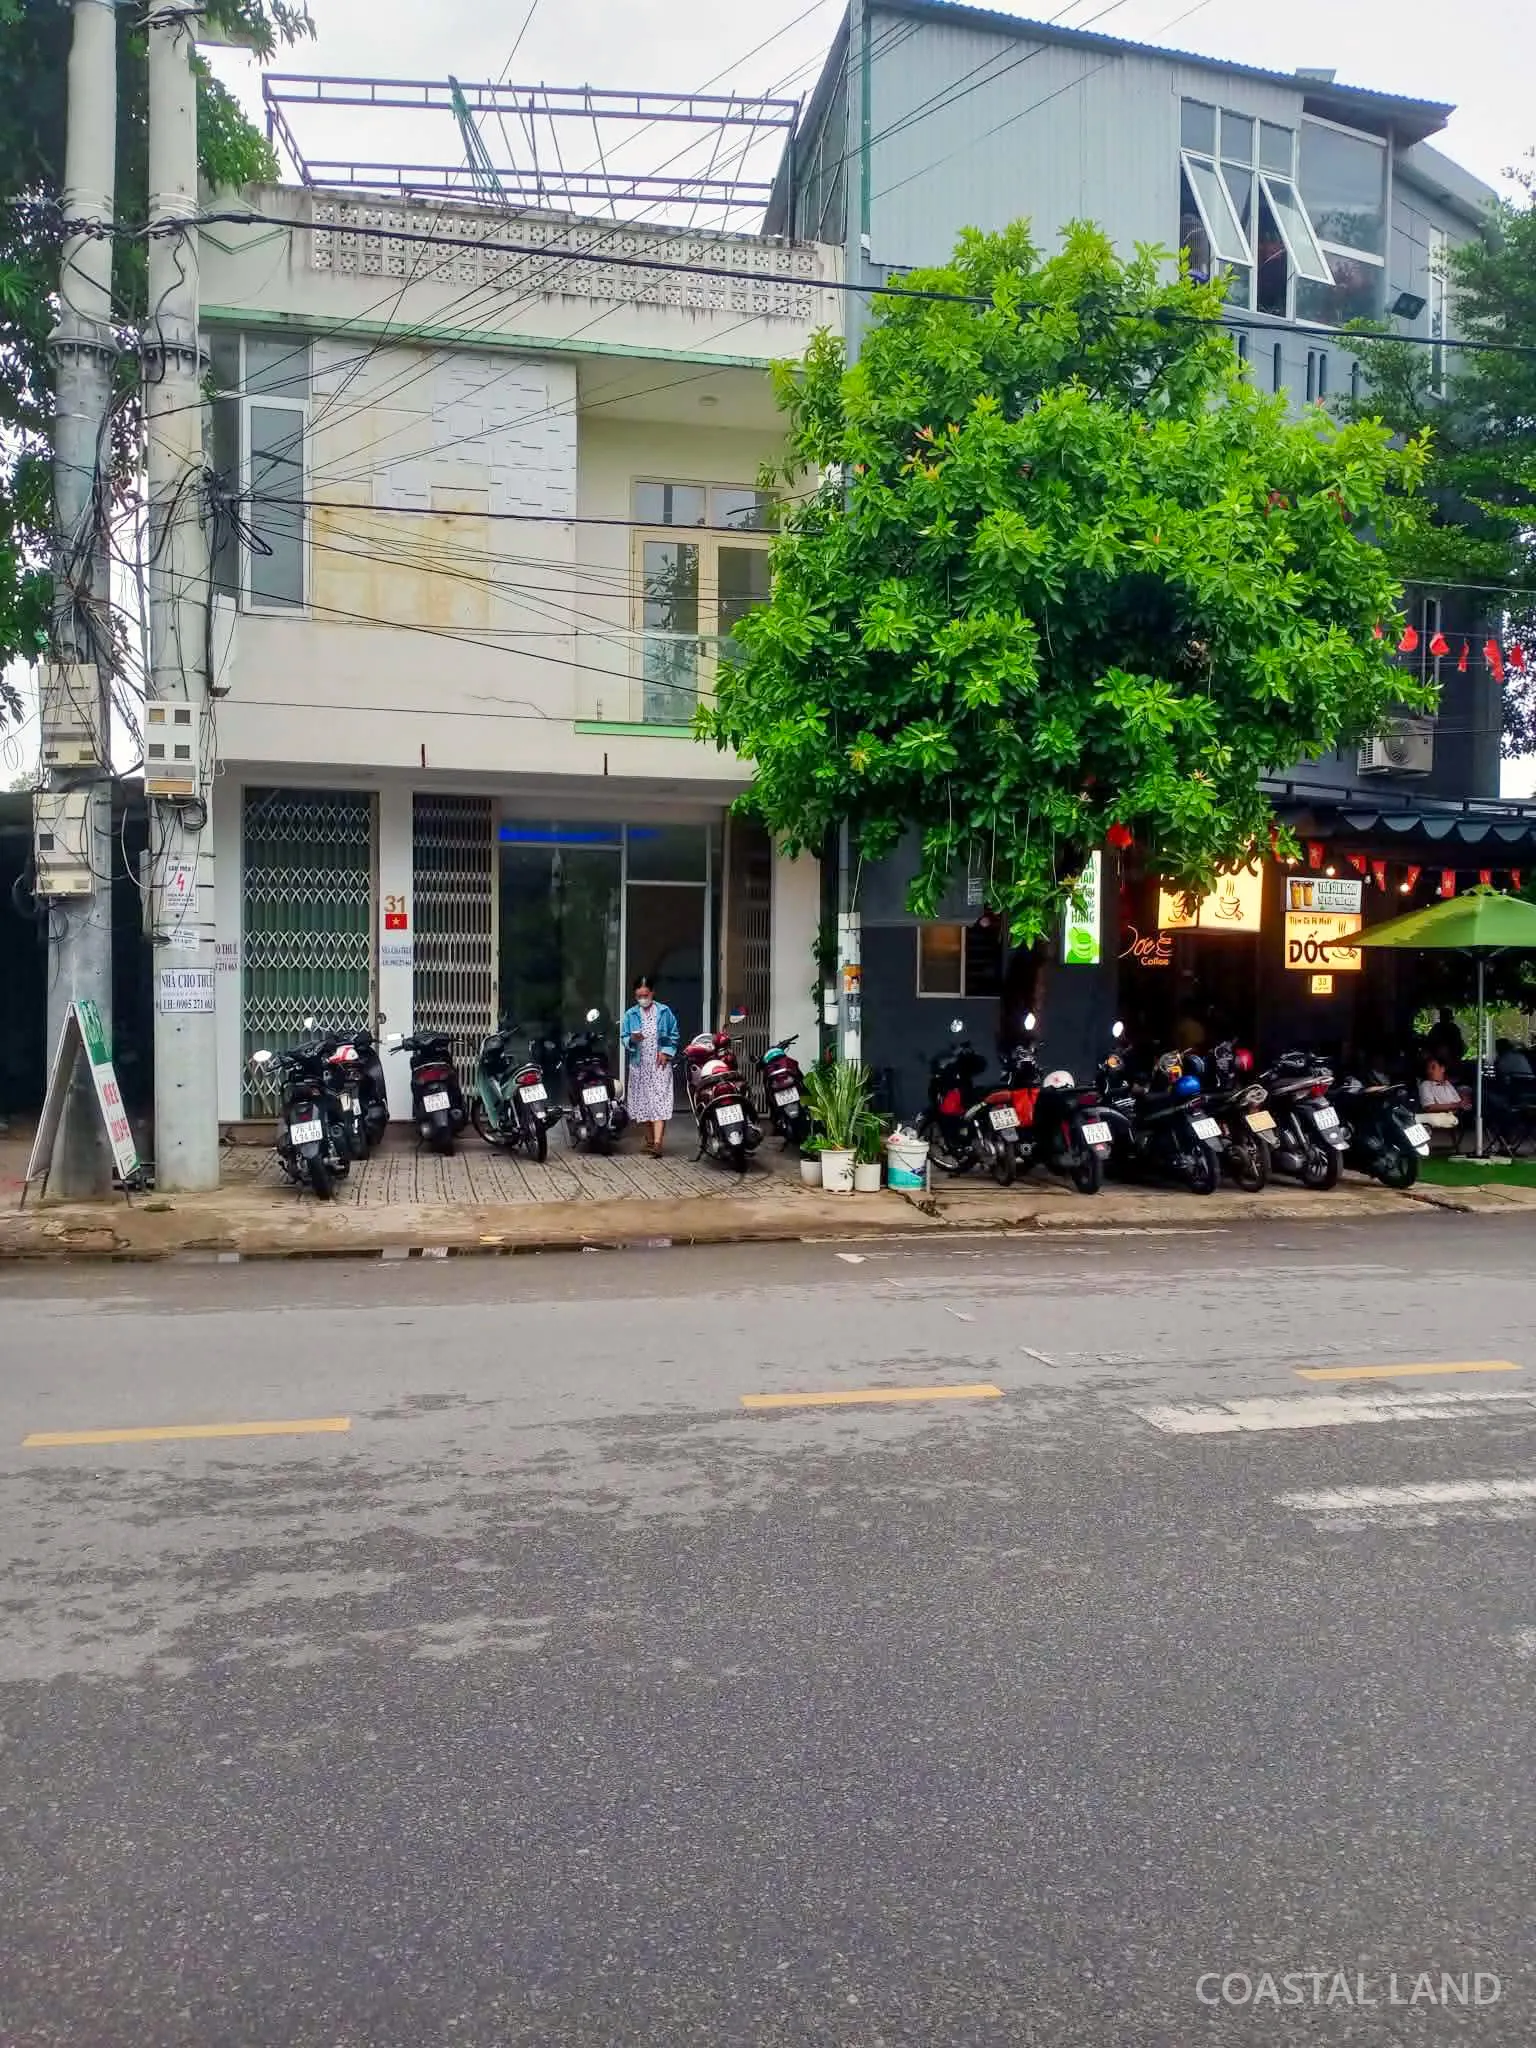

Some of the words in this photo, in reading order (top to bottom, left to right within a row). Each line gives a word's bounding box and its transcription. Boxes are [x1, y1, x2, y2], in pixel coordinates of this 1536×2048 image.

[384, 895, 405, 913] 31
[1289, 930, 1330, 963] DỐC
[178, 975, 196, 988] CHO
[1318, 978, 1328, 986] 33
